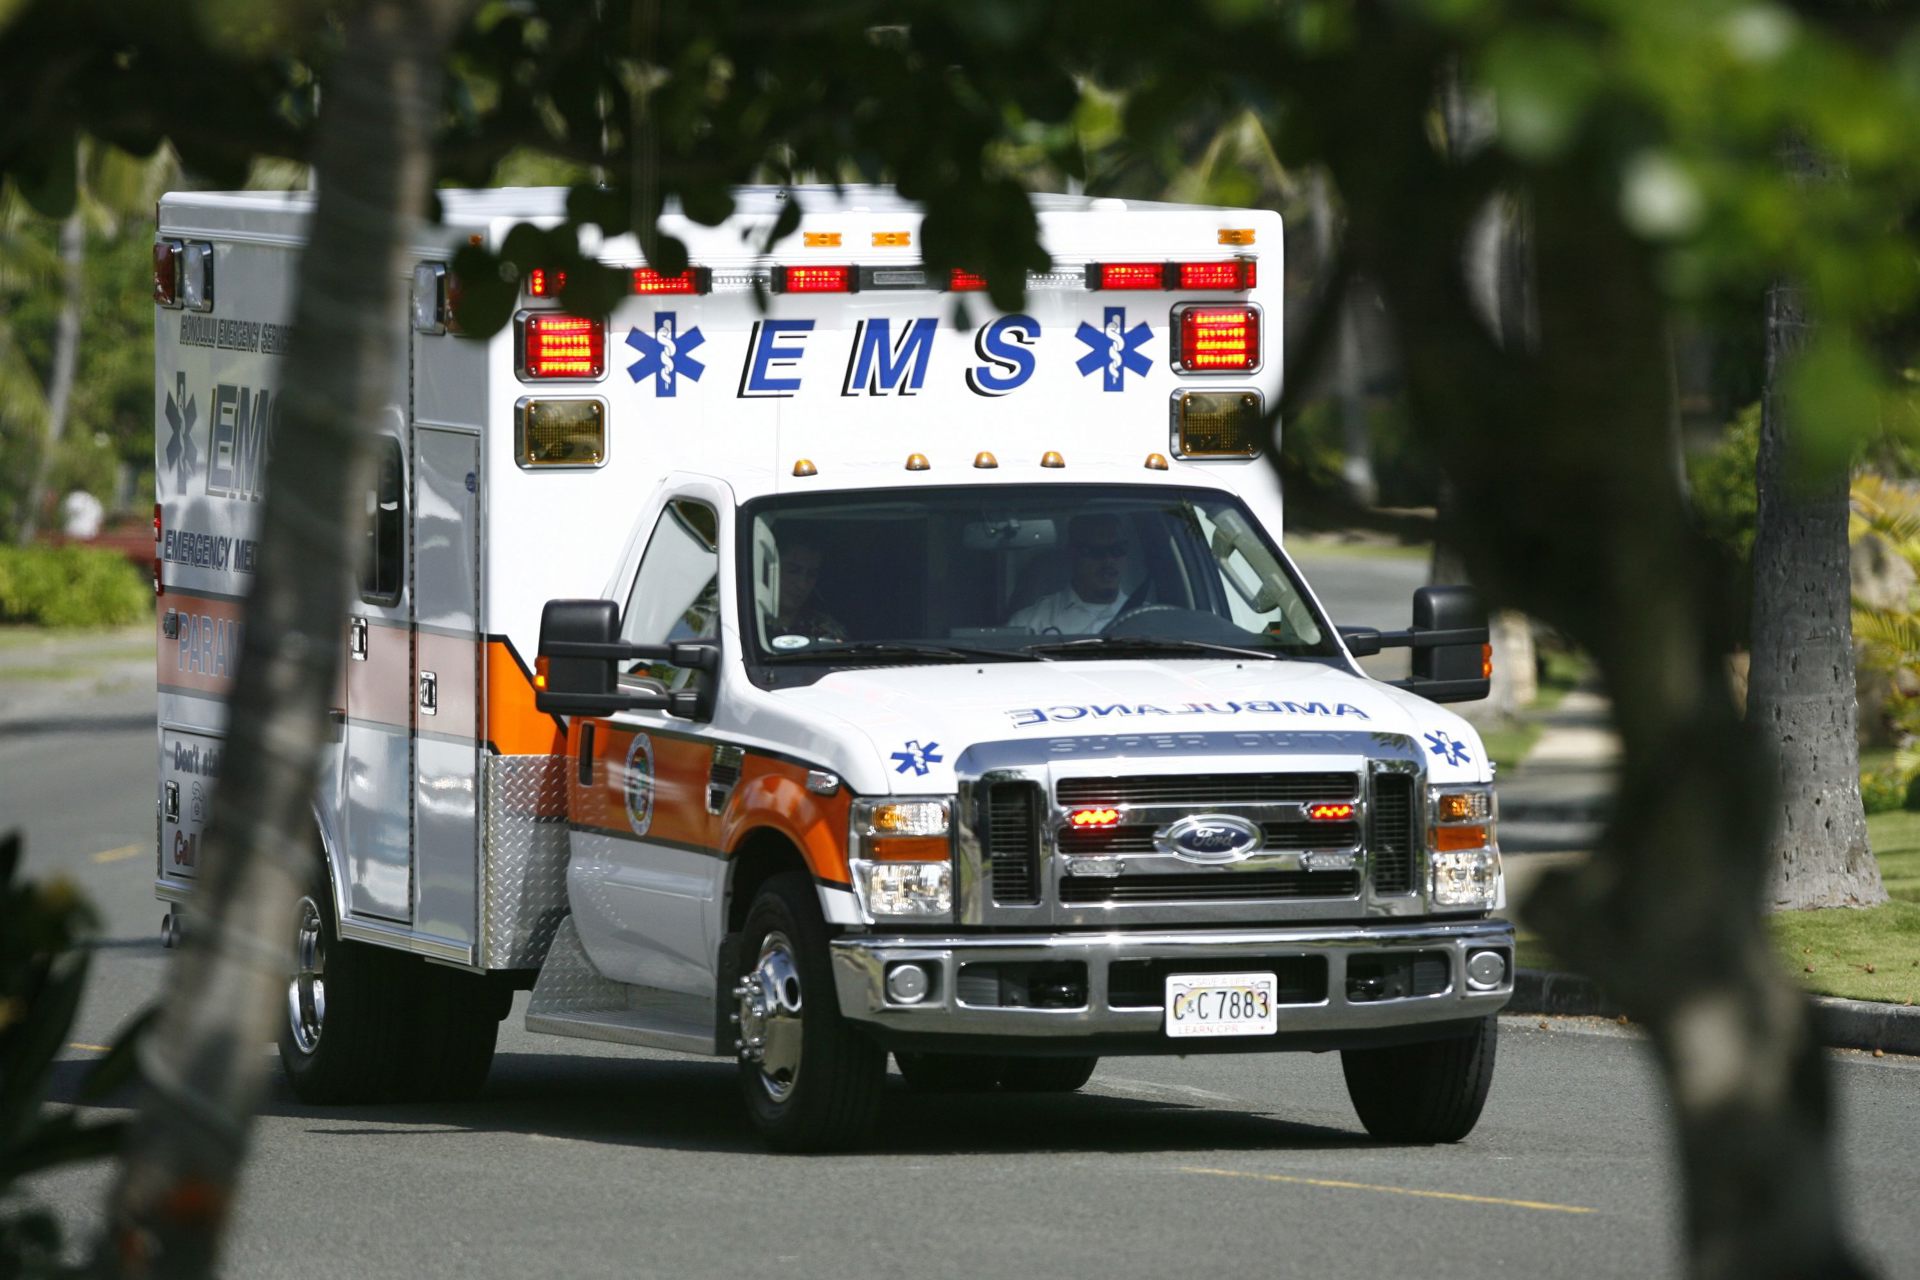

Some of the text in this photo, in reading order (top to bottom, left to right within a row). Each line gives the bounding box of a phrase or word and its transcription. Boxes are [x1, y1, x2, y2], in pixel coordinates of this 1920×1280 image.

[179, 315, 217, 348] HONOLULU
[217, 319, 261, 353] EMERGENCY
[737, 313, 1042, 398] EMS
[163, 530, 232, 571] EMERGENCY
[174, 741, 199, 774] Don't
[1049, 732, 1352, 752] SUPER DUTY
[1192, 827, 1236, 847] Ford
[1216, 990, 1269, 1019] 7883
[1178, 1024, 1239, 1035] LEARN CPR
